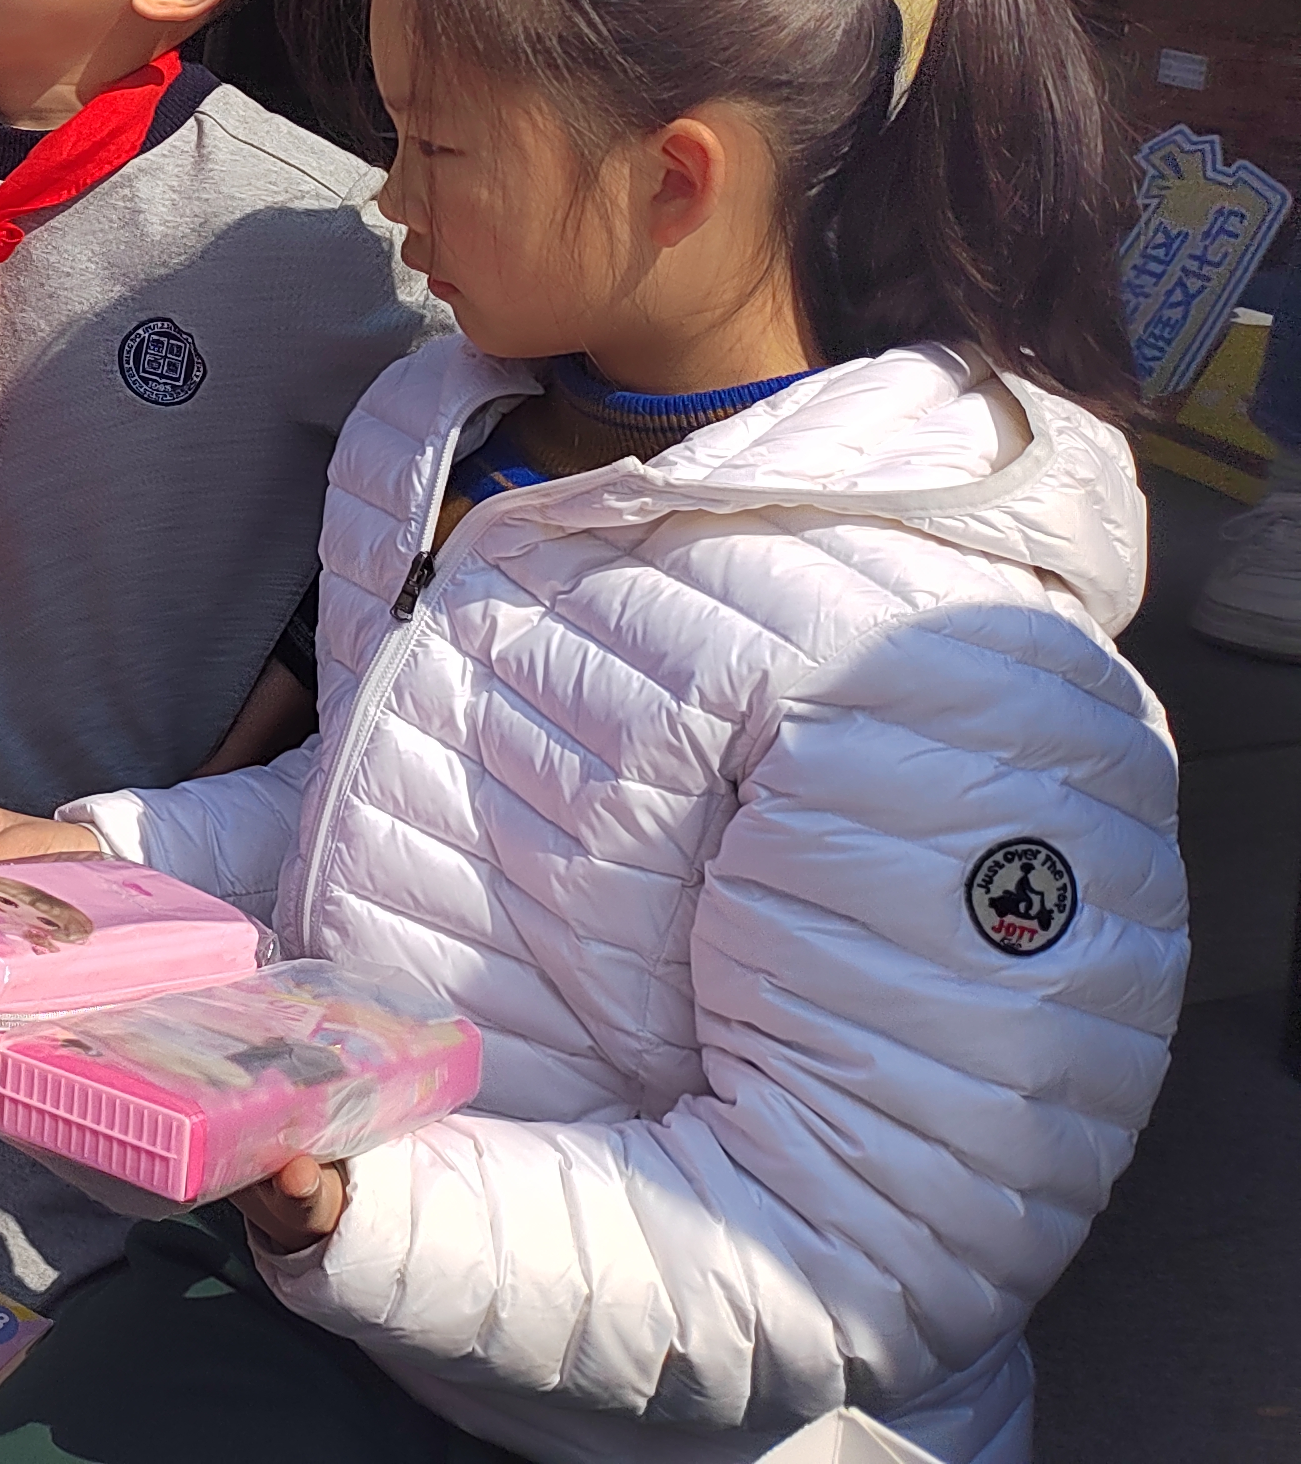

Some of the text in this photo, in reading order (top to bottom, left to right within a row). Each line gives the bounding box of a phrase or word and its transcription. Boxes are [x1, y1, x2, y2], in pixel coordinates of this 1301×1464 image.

[976, 859, 1006, 895] Just
[1002, 848, 1043, 864] Over
[1040, 853, 1066, 882] The
